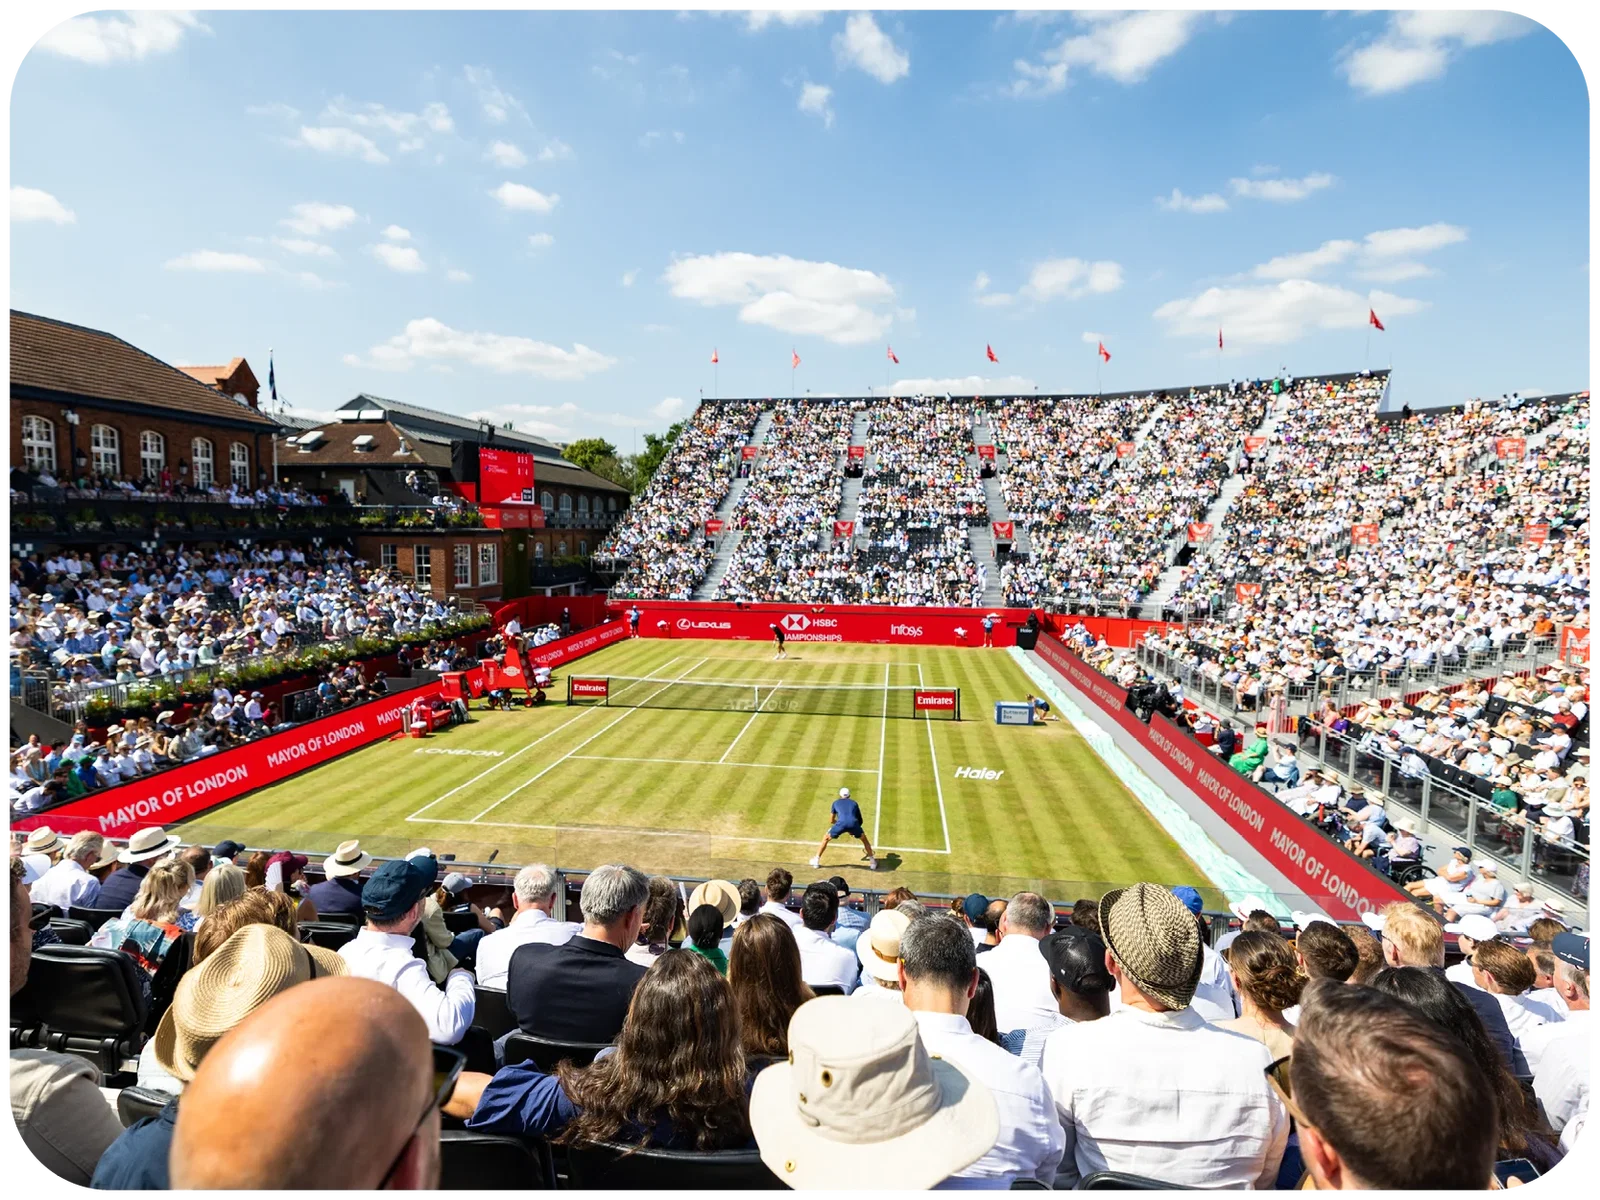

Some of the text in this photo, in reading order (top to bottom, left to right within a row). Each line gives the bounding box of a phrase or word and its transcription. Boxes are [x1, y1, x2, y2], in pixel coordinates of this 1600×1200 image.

[691, 621, 731, 629] LEXUS
[812, 619, 838, 628] HSBC
[784, 633, 842, 642] AMPIONSHIPS
[890, 624, 923, 638] Infosys
[573, 683, 607, 692] Emirates
[917, 696, 953, 705] Emirates
[267, 721, 365, 768] MAYOR OF LONDON
[1148, 727, 1195, 773] MAYOR OF LONDON
[413, 748, 504, 757] LONDON
[954, 766, 1004, 780] Haier
[98, 764, 248, 832] MAYOR OF LONDON
[1196, 768, 1265, 832] MAYOR OF LONDON
[1269, 827, 1306, 867] MAYOR
[1304, 856, 1324, 880] OF
